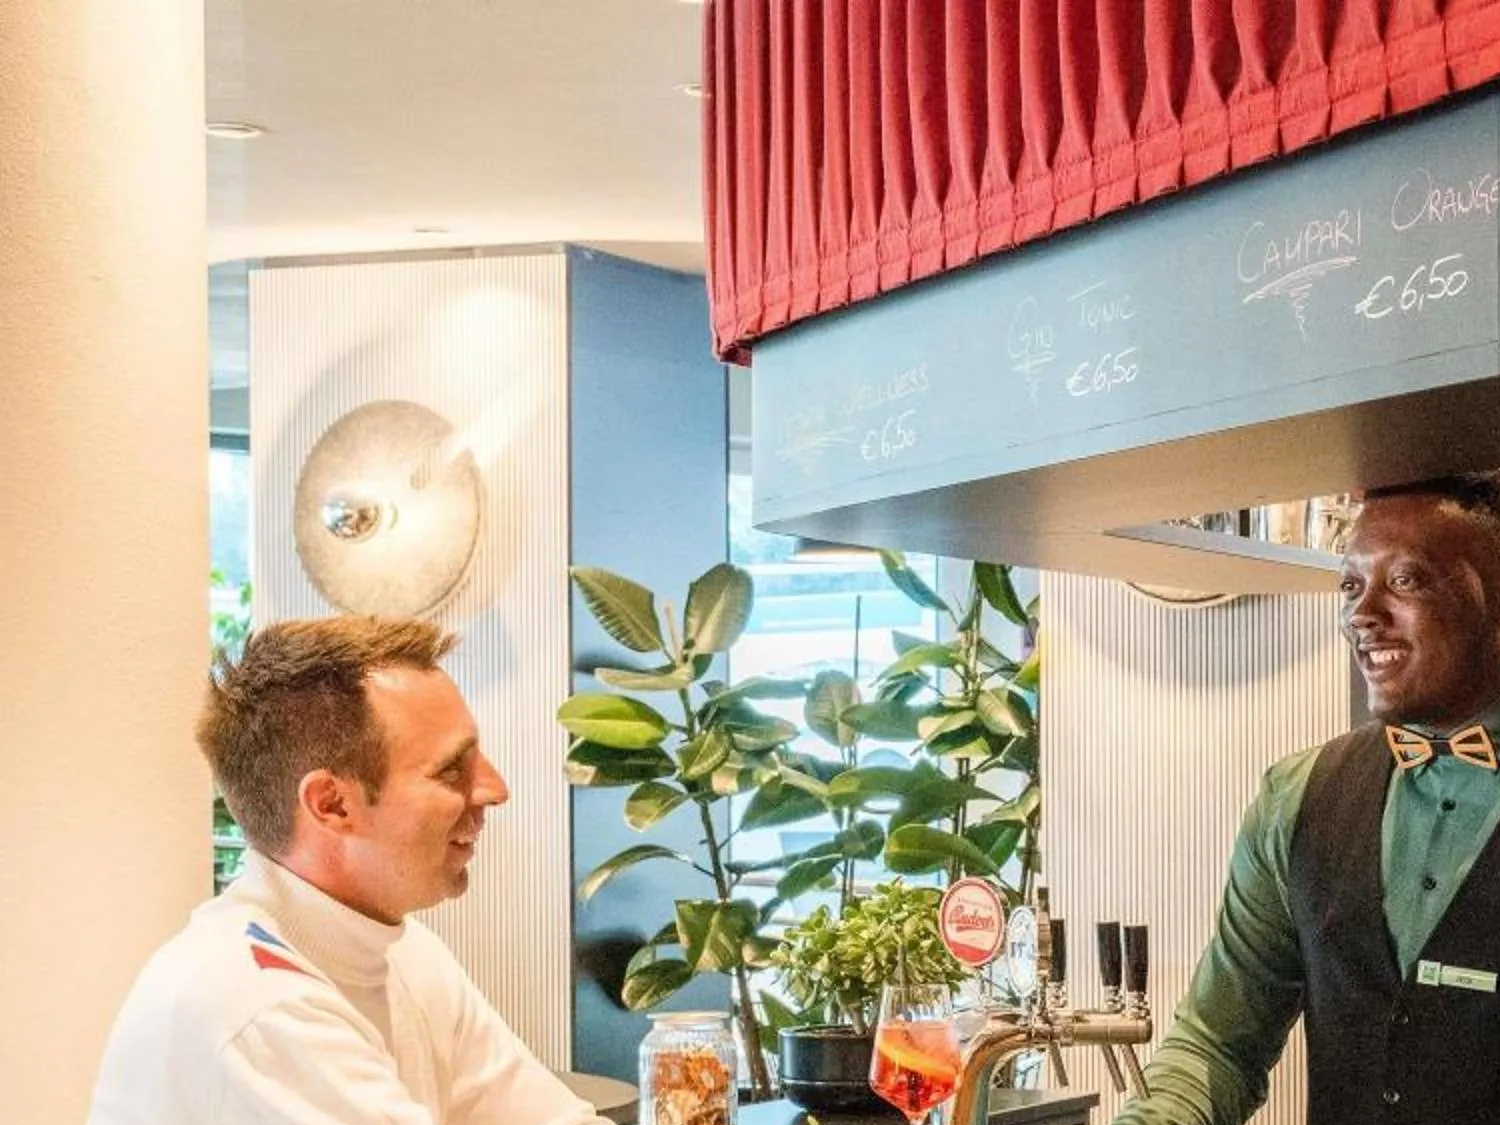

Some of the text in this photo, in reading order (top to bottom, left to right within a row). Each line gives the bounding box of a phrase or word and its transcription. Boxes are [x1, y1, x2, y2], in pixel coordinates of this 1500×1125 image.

[1236, 208, 1362, 284] CAMPARI
[1353, 252, 1469, 319] €6,50
[1065, 346, 1140, 397] €6,50
